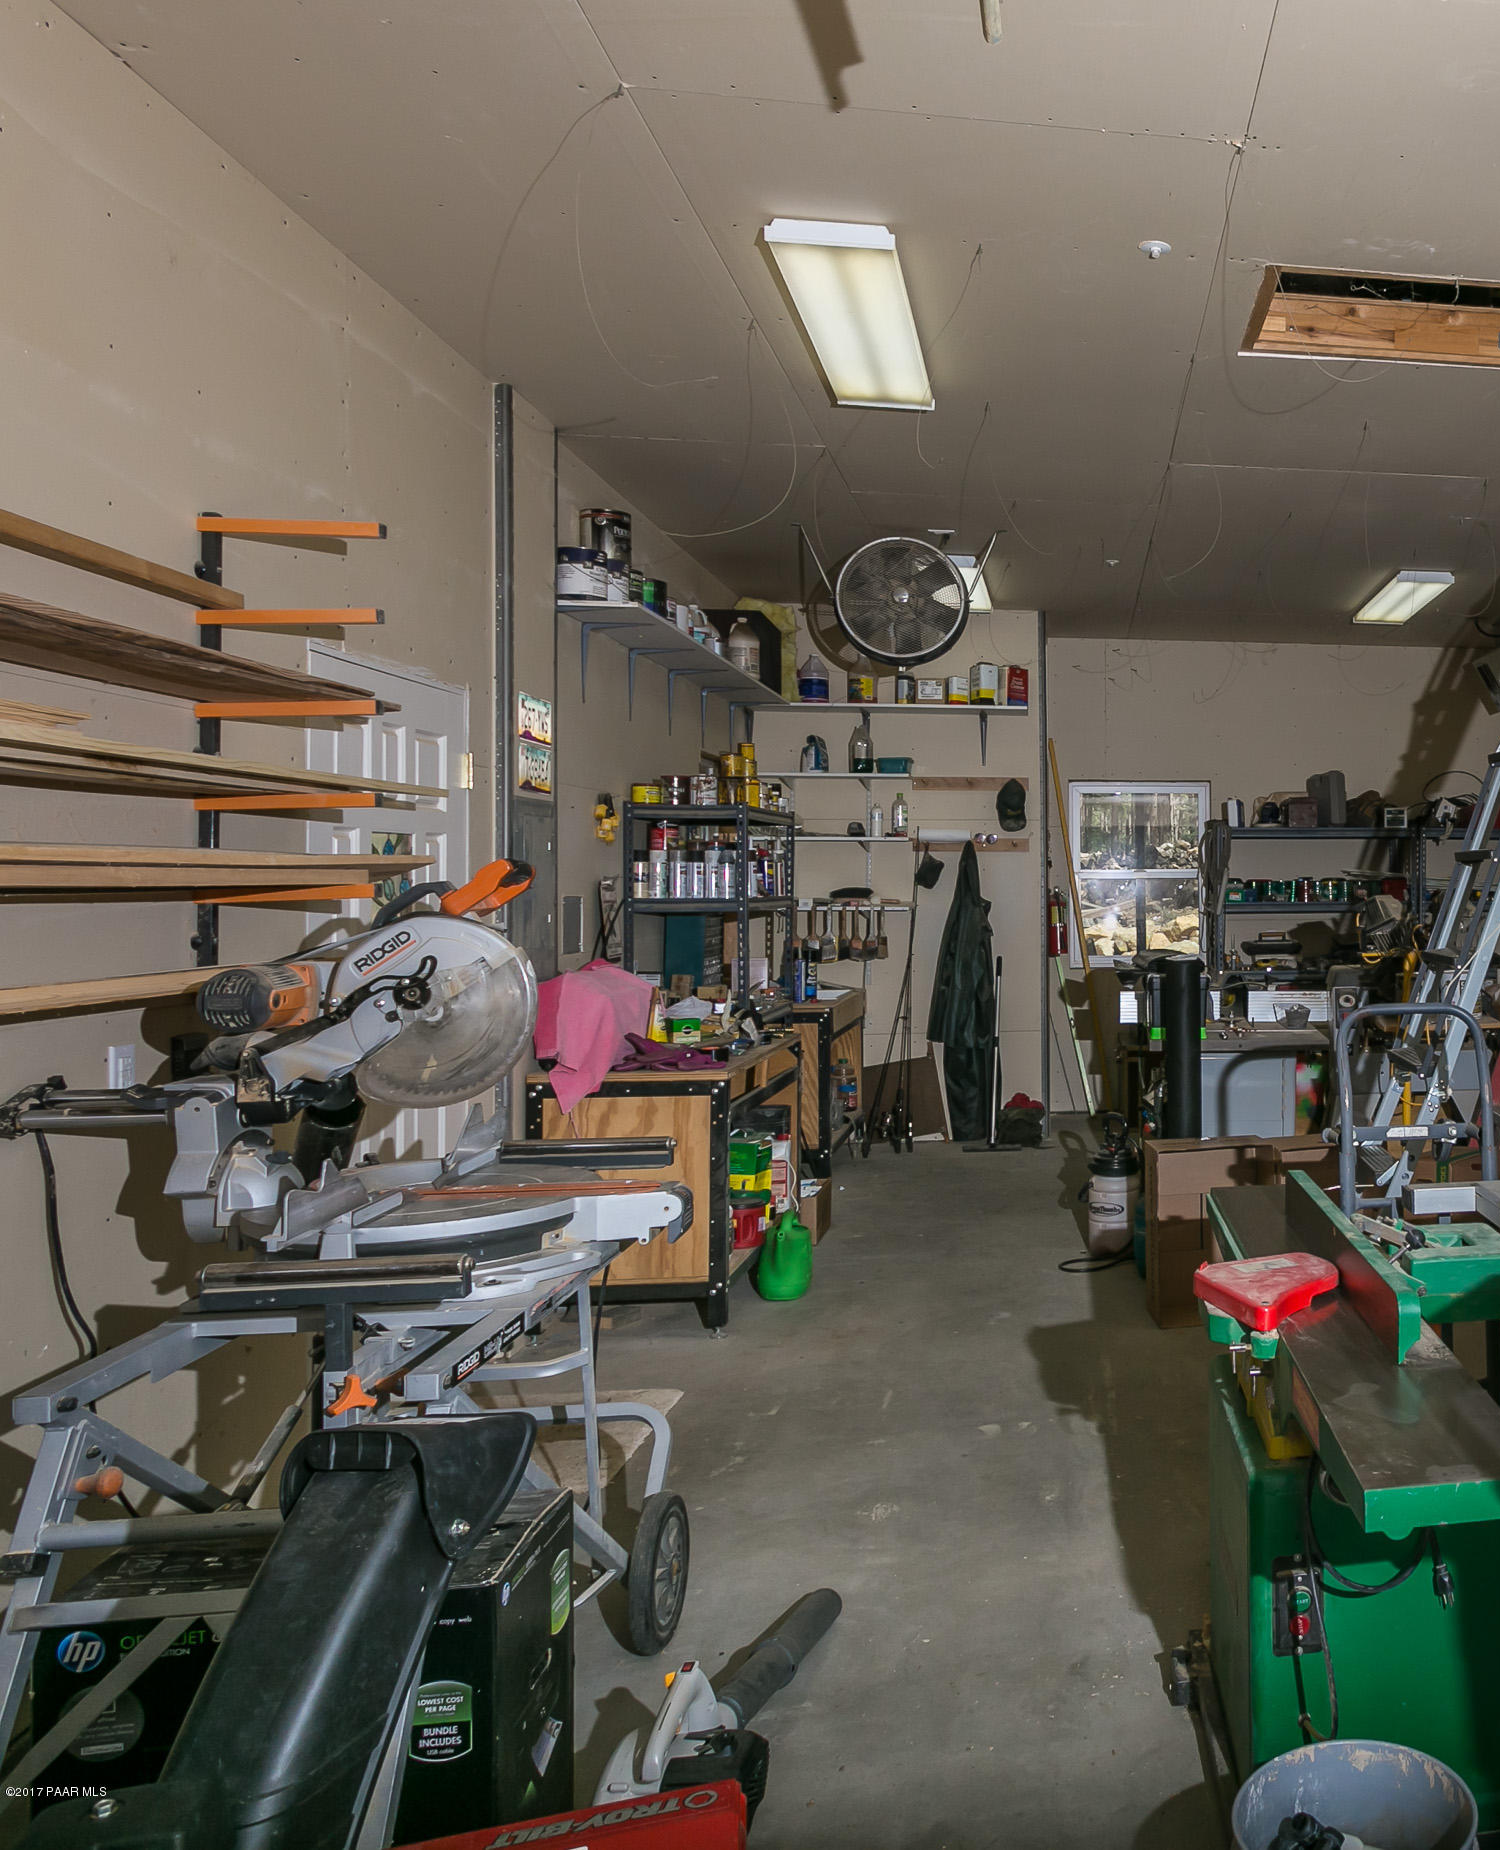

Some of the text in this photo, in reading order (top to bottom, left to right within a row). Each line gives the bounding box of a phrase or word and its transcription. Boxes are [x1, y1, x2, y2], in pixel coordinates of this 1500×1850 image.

[353, 931, 411, 972] RIDGID
[457, 1350, 480, 1376] RIDGID
[63, 1631, 101, 1673] hp
[417, 1695, 464, 1707] LOWEST COST
[438, 1704, 457, 1712] PAGE
[423, 1725, 459, 1737] BUNDLE
[418, 1735, 463, 1748] INCLUDES
[488, 1797, 682, 1850] TROY-BILT
